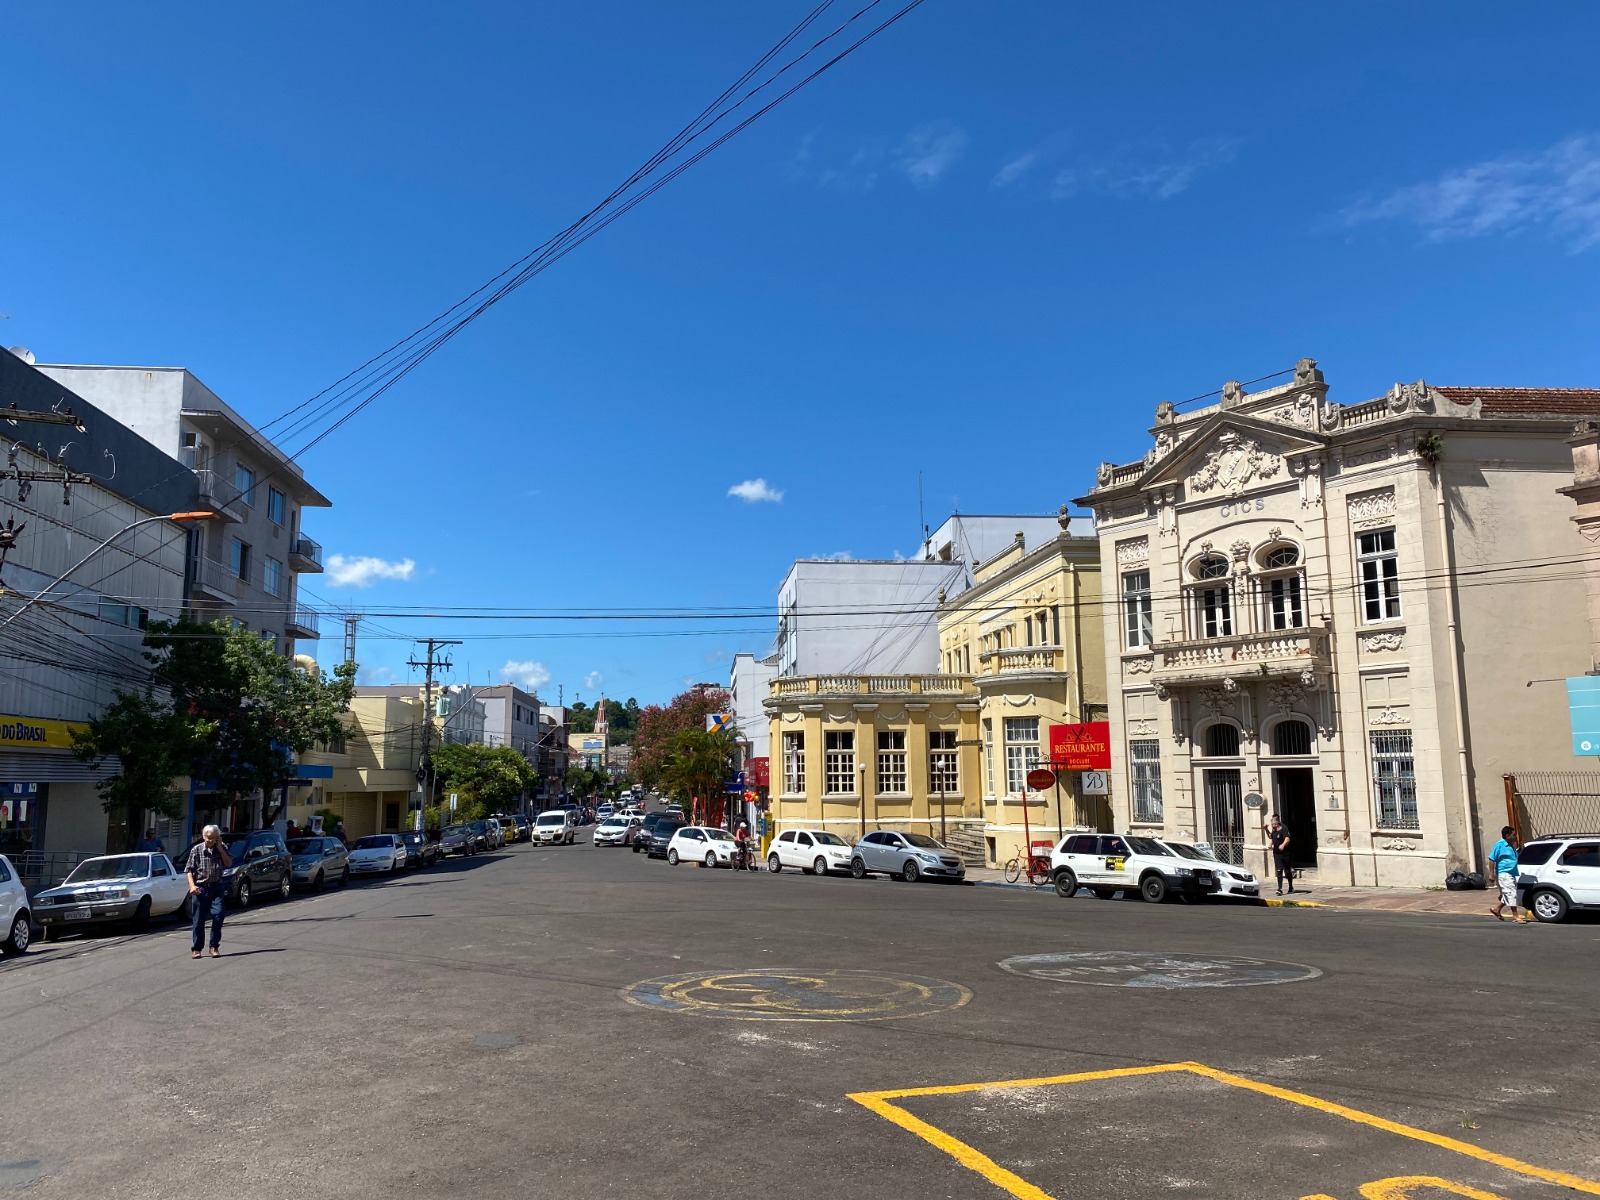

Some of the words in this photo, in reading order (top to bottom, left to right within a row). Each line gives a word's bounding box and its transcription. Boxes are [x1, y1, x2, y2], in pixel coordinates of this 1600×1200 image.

[1220, 498, 1264, 518] CICS
[2, 724, 15, 740] DO
[16, 722, 47, 742] BRASIL
[1054, 743, 1105, 753] RESTAURANTE
